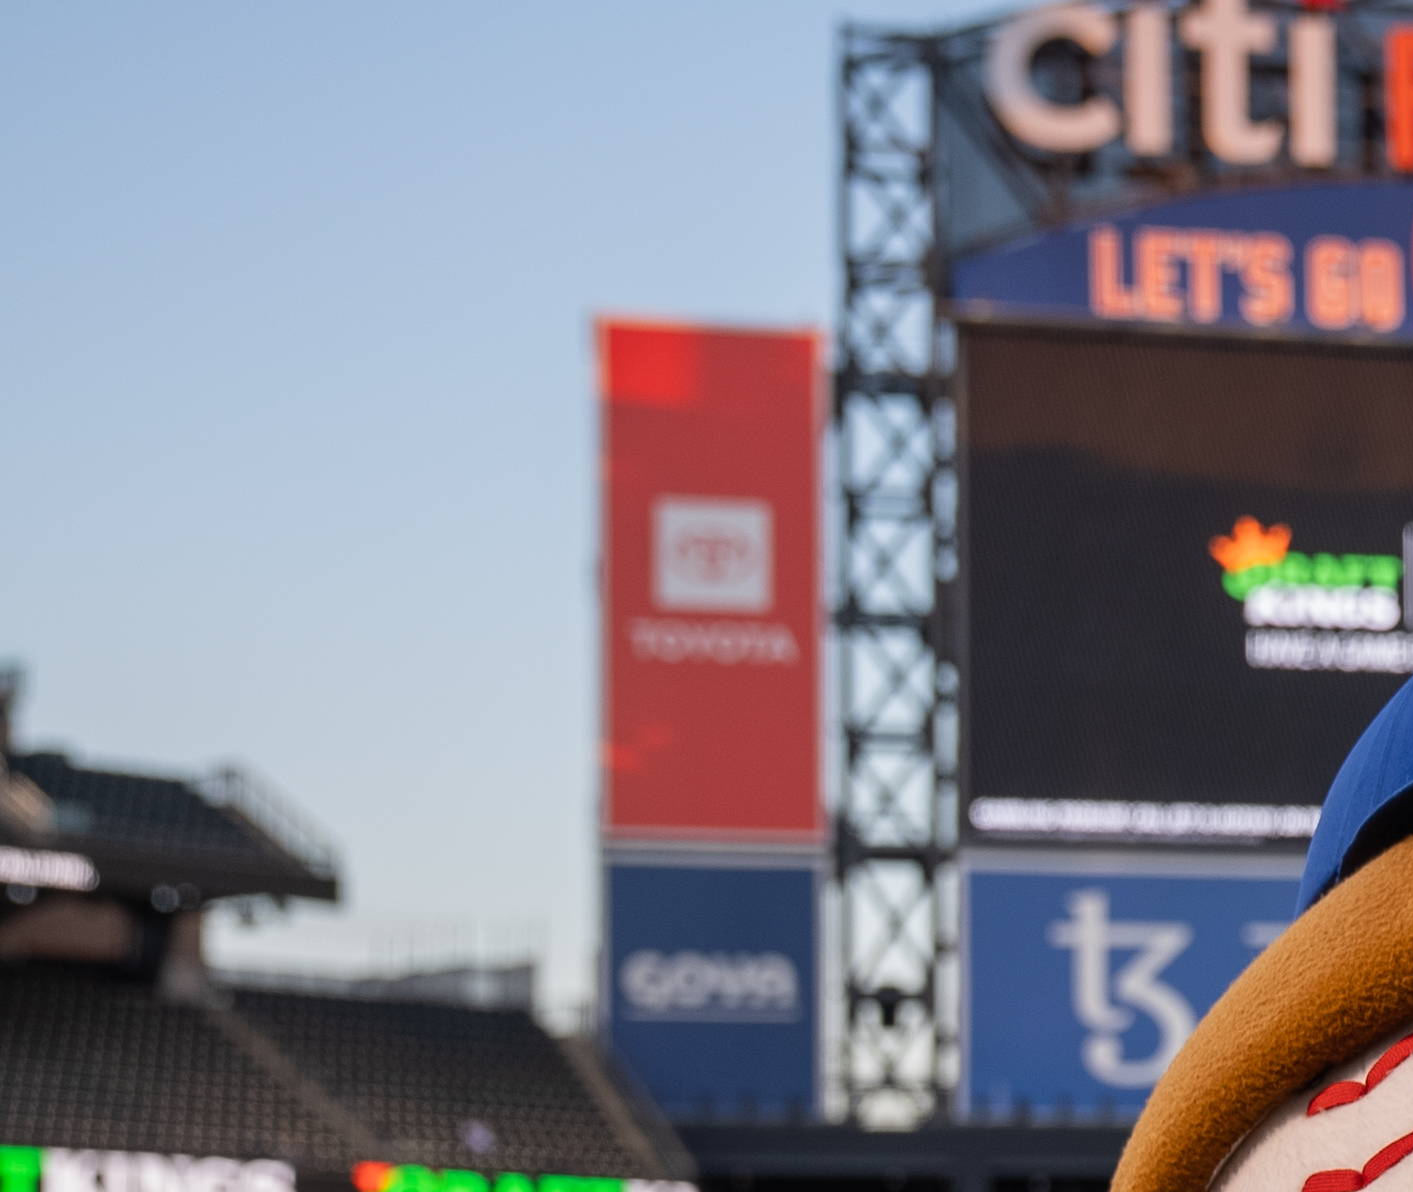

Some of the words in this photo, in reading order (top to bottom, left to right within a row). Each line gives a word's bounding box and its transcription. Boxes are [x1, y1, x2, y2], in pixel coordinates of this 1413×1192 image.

[983, 0, 1340, 167] citi
[1088, 222, 1296, 327] LET'S
[1306, 234, 1405, 333] GO
[626, 617, 800, 664] TOYOTA
